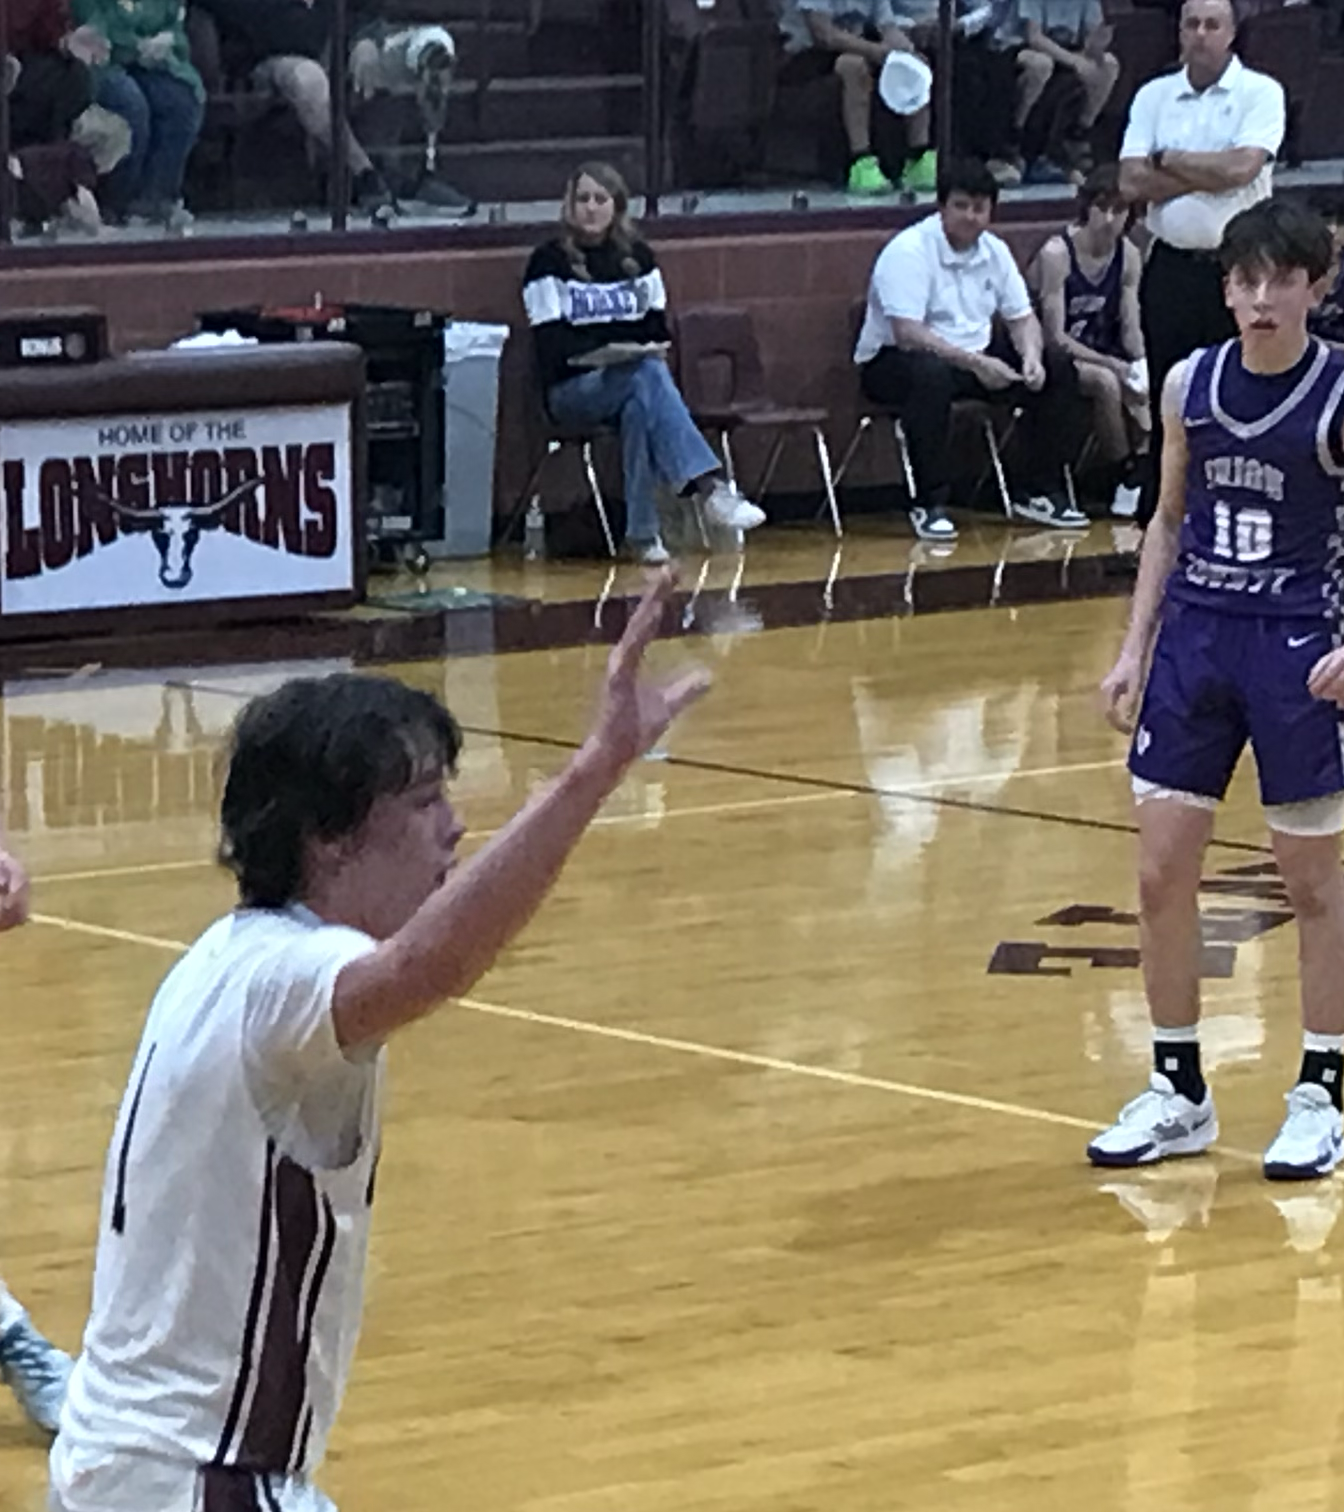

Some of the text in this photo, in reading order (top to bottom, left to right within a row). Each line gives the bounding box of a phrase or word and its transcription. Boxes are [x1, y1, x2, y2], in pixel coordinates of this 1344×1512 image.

[98, 420, 246, 446] HOME OF THE
[3, 442, 337, 580] LONGHORNS
[1213, 500, 1273, 562] 10
